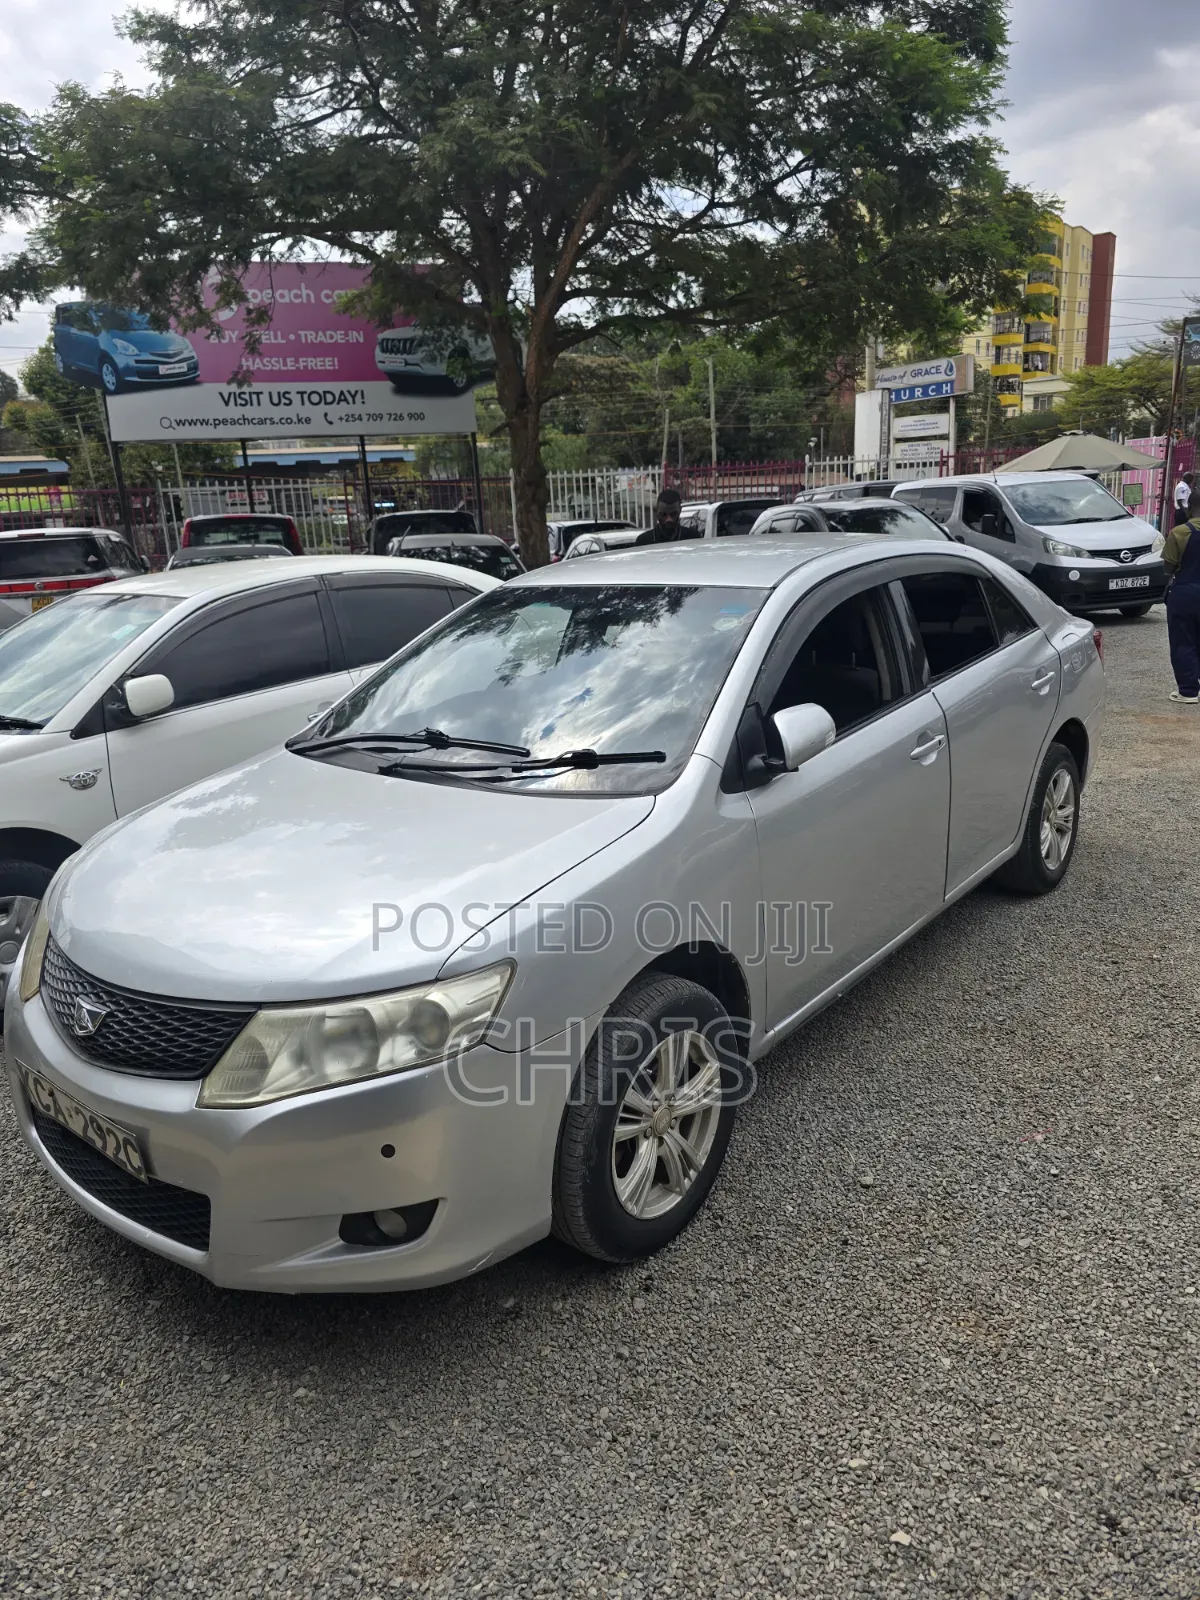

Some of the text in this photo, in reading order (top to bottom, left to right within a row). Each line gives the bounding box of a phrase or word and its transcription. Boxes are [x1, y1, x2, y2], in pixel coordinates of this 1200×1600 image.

[248, 283, 315, 306] peach
[298, 331, 364, 343] TRADE-IN
[242, 357, 339, 370] HASSLE-FREE!
[910, 365, 942, 378] GRACE
[218, 390, 366, 407] VISIT US TODAY!
[890, 383, 951, 402] HURCH
[174, 412, 426, 429] www.peachcars.co.ke +254 709 726 900
